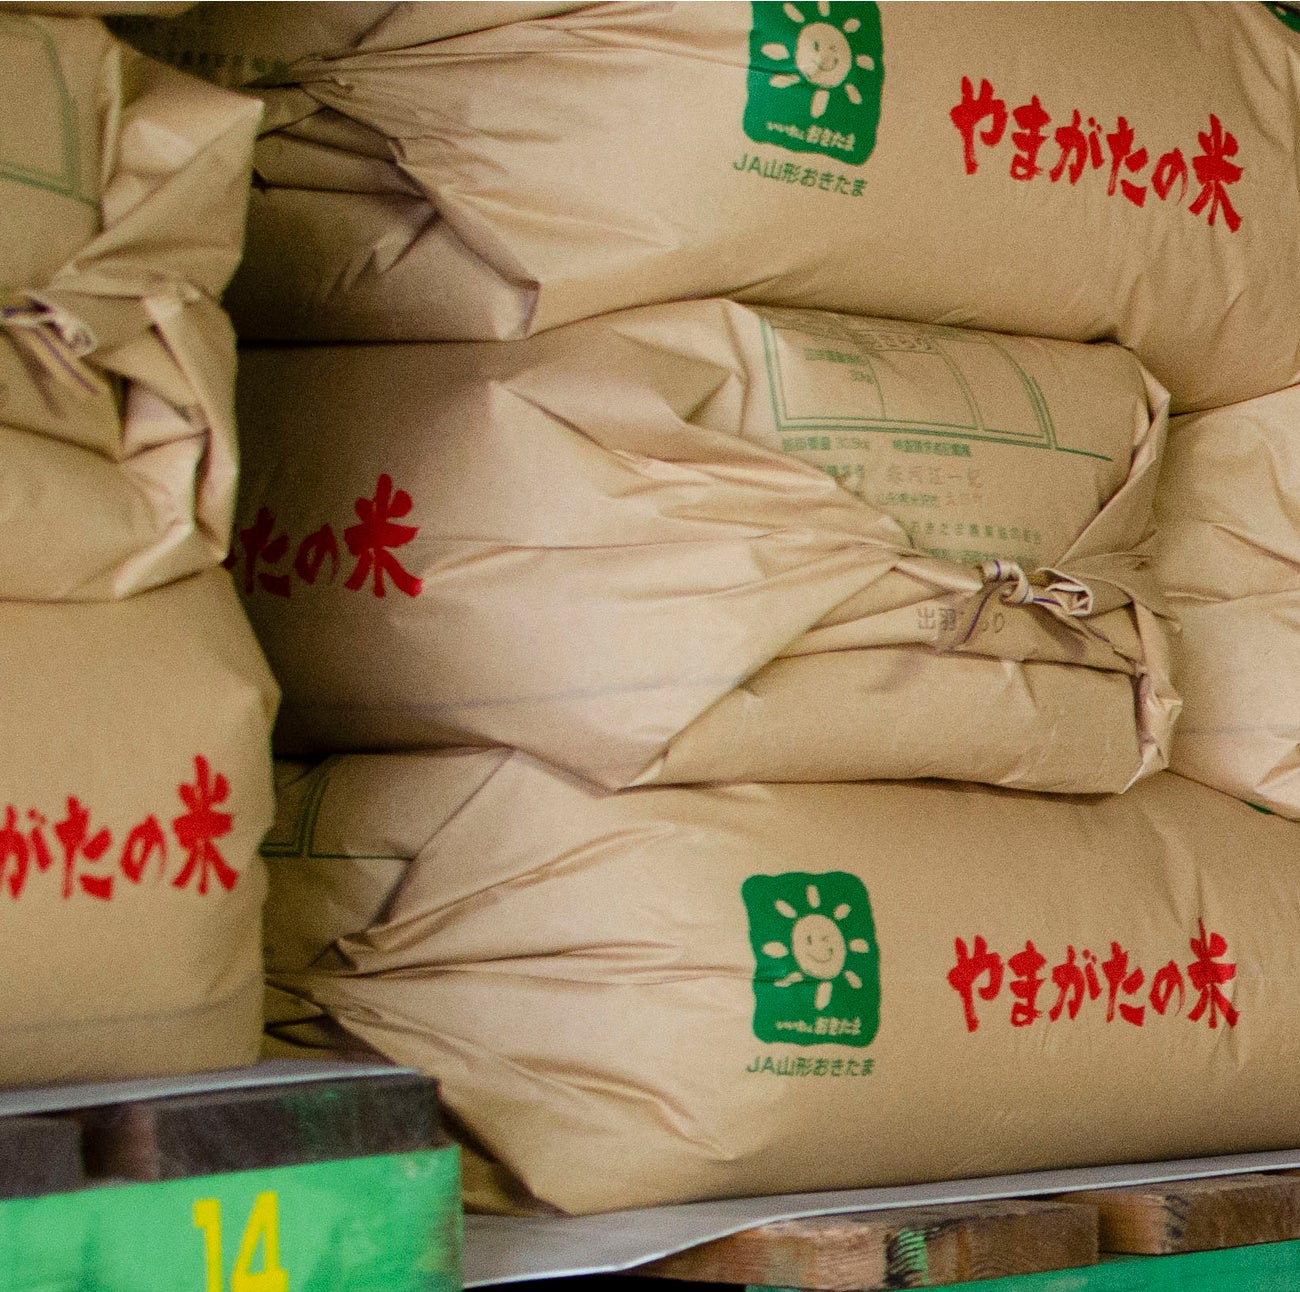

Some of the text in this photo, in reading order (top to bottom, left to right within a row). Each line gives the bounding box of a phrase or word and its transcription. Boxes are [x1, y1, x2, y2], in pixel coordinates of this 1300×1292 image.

[733, 157, 867, 197] JA山形おきたま
[950, 76, 1244, 233] やまがたの米
[221, 473, 423, 598] たの米
[947, 917, 1240, 1032] やまがたの米
[746, 1055, 875, 1078] JA山形おきたま
